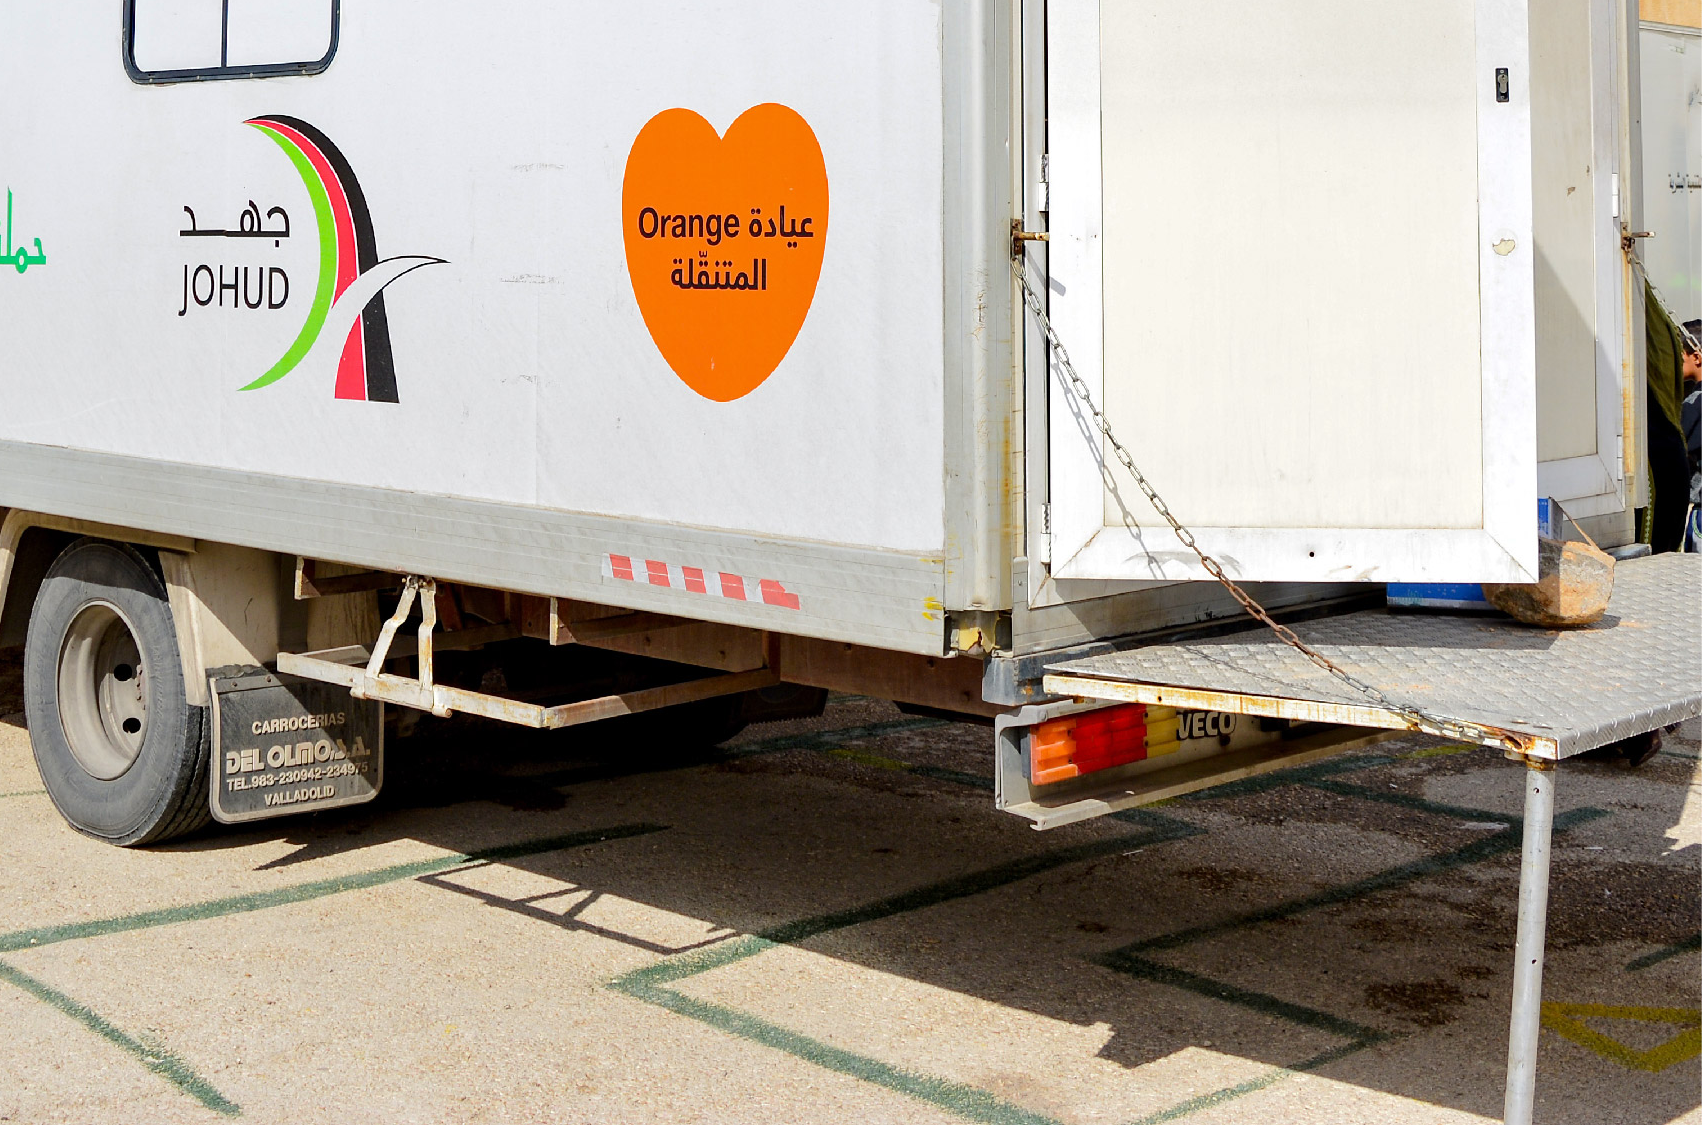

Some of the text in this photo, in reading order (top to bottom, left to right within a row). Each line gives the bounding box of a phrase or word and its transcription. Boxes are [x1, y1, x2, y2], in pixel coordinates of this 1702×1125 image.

[179, 199, 290, 248] جهد
[638, 204, 814, 248] عيادة Orange
[178, 263, 290, 316] JOHUD
[251, 711, 346, 736] CARROCERIAS
[1177, 710, 1237, 741] VECO
[225, 748, 265, 775] DEL
[264, 784, 336, 807] VALLADOLID
